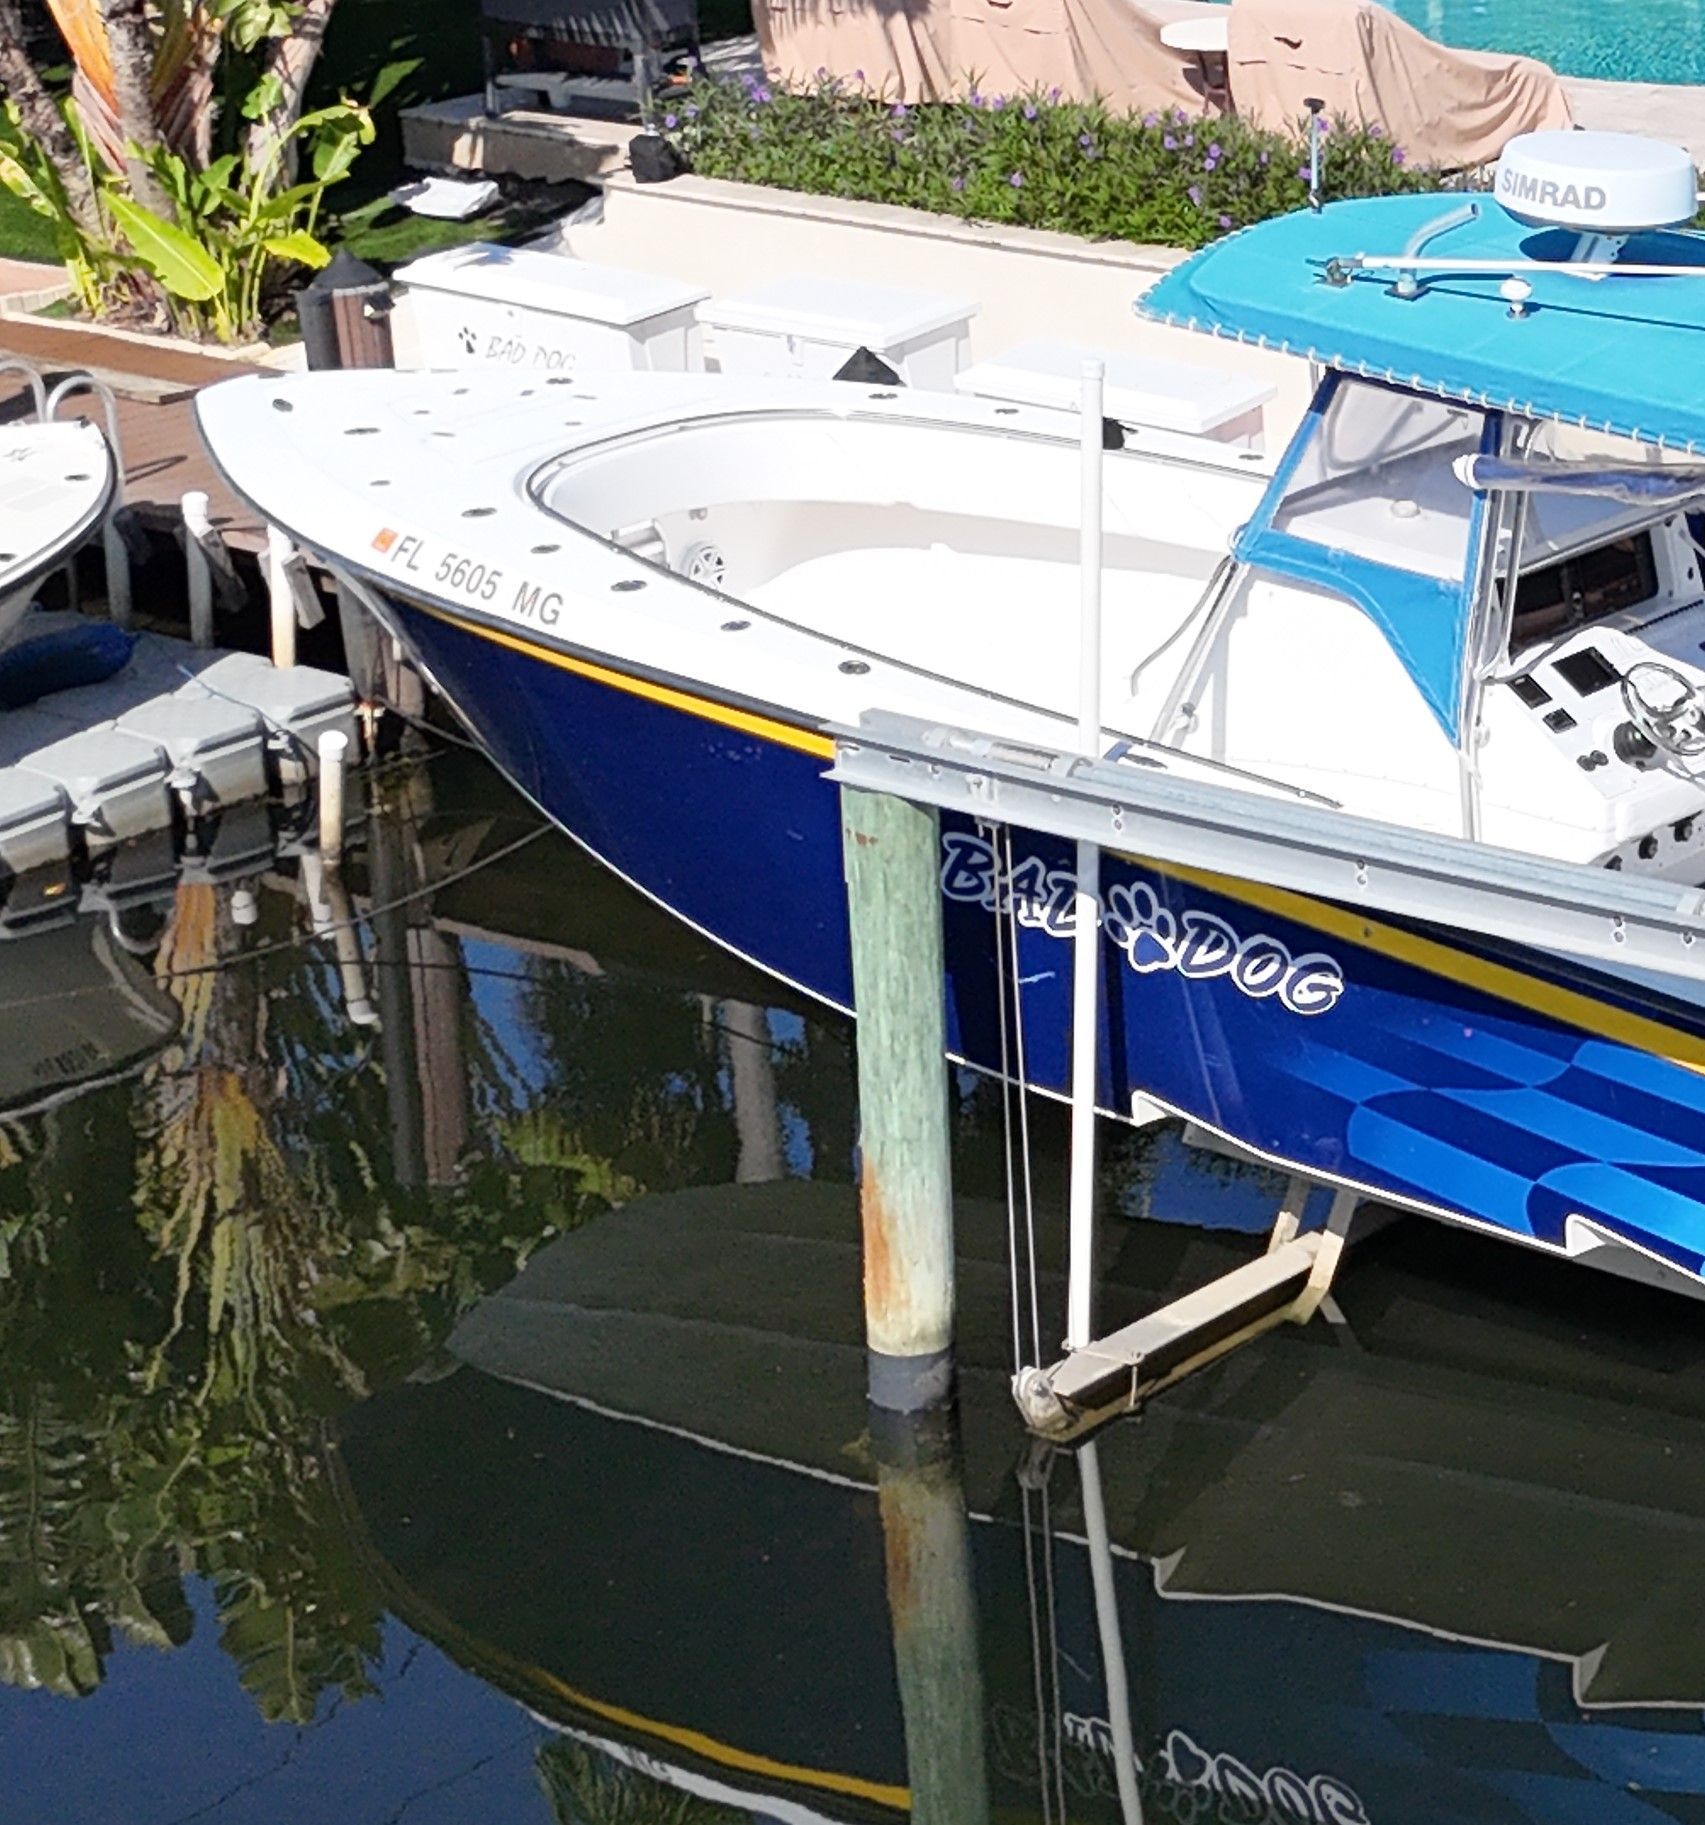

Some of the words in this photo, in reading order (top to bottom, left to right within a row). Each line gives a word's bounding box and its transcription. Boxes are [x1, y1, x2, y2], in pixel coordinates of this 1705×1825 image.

[1501, 168, 1607, 211] SIMRAD
[485, 335, 527, 364] BAD
[391, 535, 425, 572] FL
[435, 552, 503, 600] 5605
[512, 581, 564, 626] MG
[1176, 910, 1345, 1015] DOG
